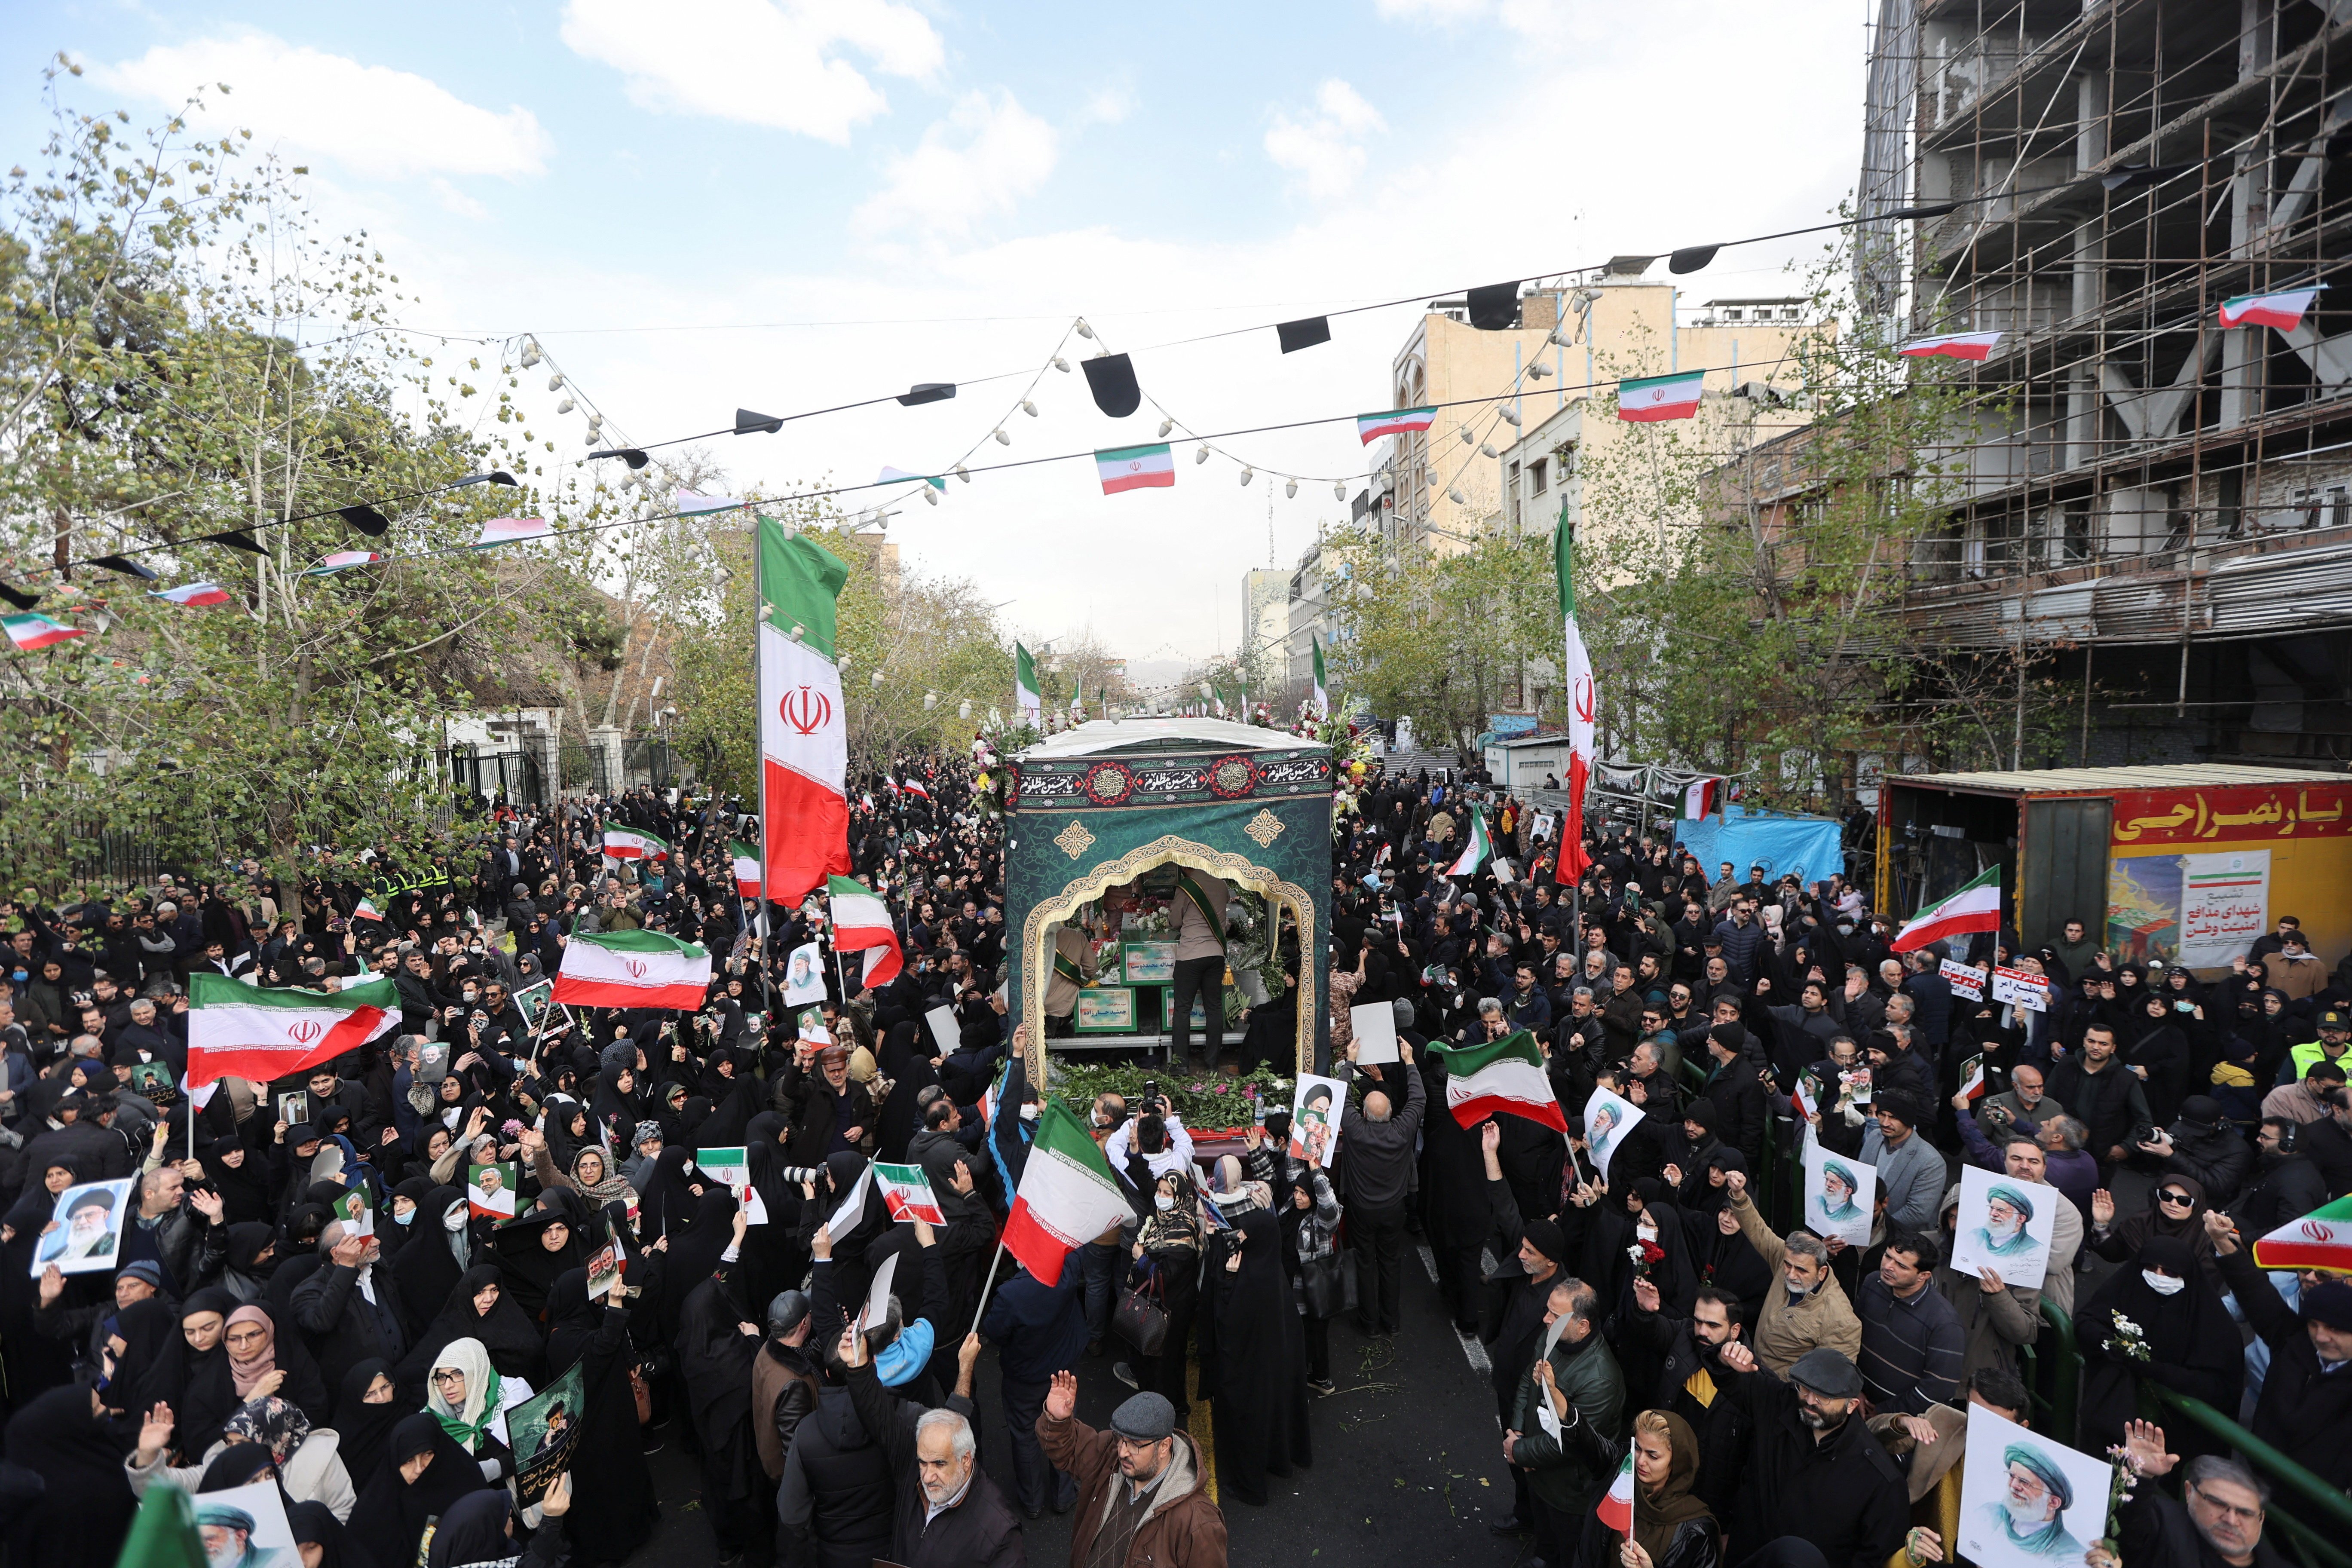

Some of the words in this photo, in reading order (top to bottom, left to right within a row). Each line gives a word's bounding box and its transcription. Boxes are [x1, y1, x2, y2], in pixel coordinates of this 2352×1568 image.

[1268, 763, 1292, 782] مظلوم
[1288, 761, 1314, 780] حسین
[1020, 776, 1046, 793] مظلوم
[1041, 776, 1067, 794] حسین
[1144, 772, 1170, 791] مظلوم
[1166, 772, 1192, 789] حسین
[2206, 888, 2244, 905] تشییع
[2187, 905, 2220, 924] مدافع
[2221, 903, 2261, 919] شهدای
[2186, 922, 2219, 938] وطن
